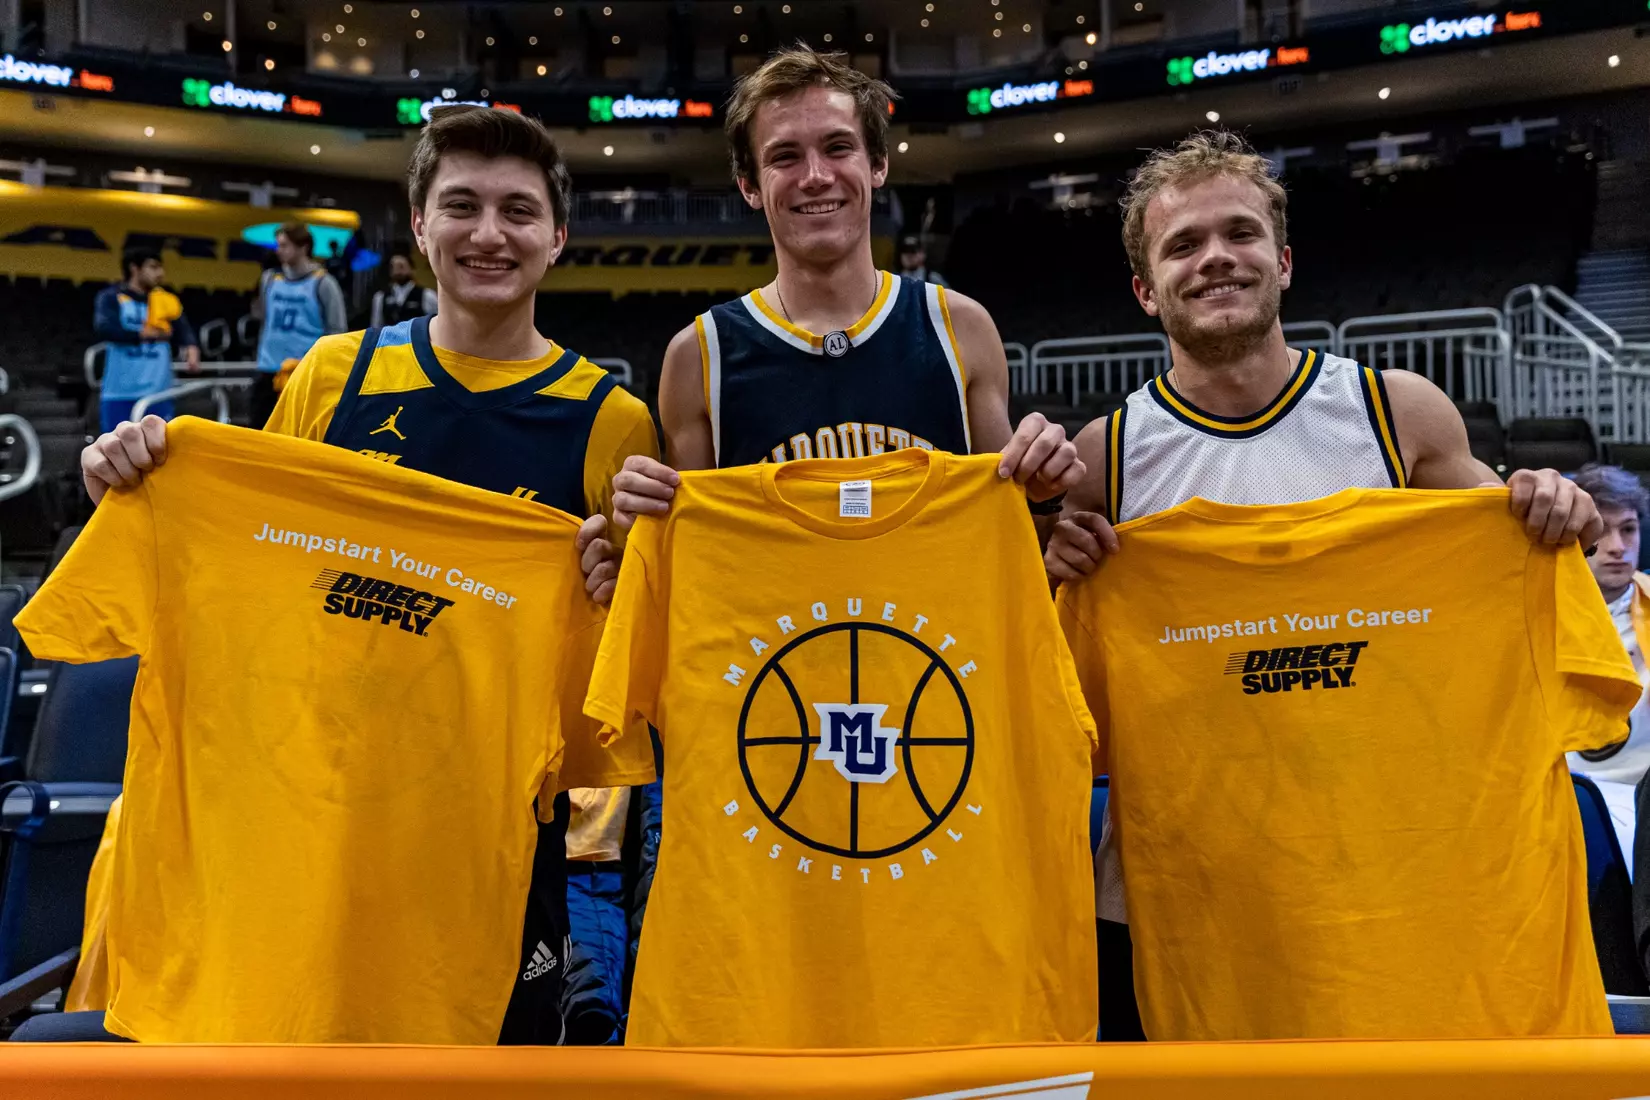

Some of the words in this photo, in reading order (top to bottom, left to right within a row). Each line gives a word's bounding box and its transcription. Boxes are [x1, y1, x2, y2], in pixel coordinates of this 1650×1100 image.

[1409, 12, 1494, 47] clover
[1193, 48, 1269, 79] clover
[209, 80, 285, 113] clover
[612, 94, 679, 120] clover
[990, 80, 1058, 108] clover
[254, 523, 382, 564] Jumpstart
[390, 548, 442, 581] Your
[445, 568, 518, 610] Career
[329, 572, 455, 617] DIRECT
[323, 593, 434, 636] SUPPLY
[1158, 614, 1279, 645] Jumpstart
[1283, 612, 1341, 632] Your
[1346, 608, 1432, 629] Career
[723, 598, 977, 686] MARQUETTE
[1243, 641, 1369, 673] DIRECT
[1242, 666, 1355, 695] SUPPLY
[828, 712, 888, 775] MU
[723, 799, 982, 884] BASKETBALL
[523, 956, 558, 981] adidas
